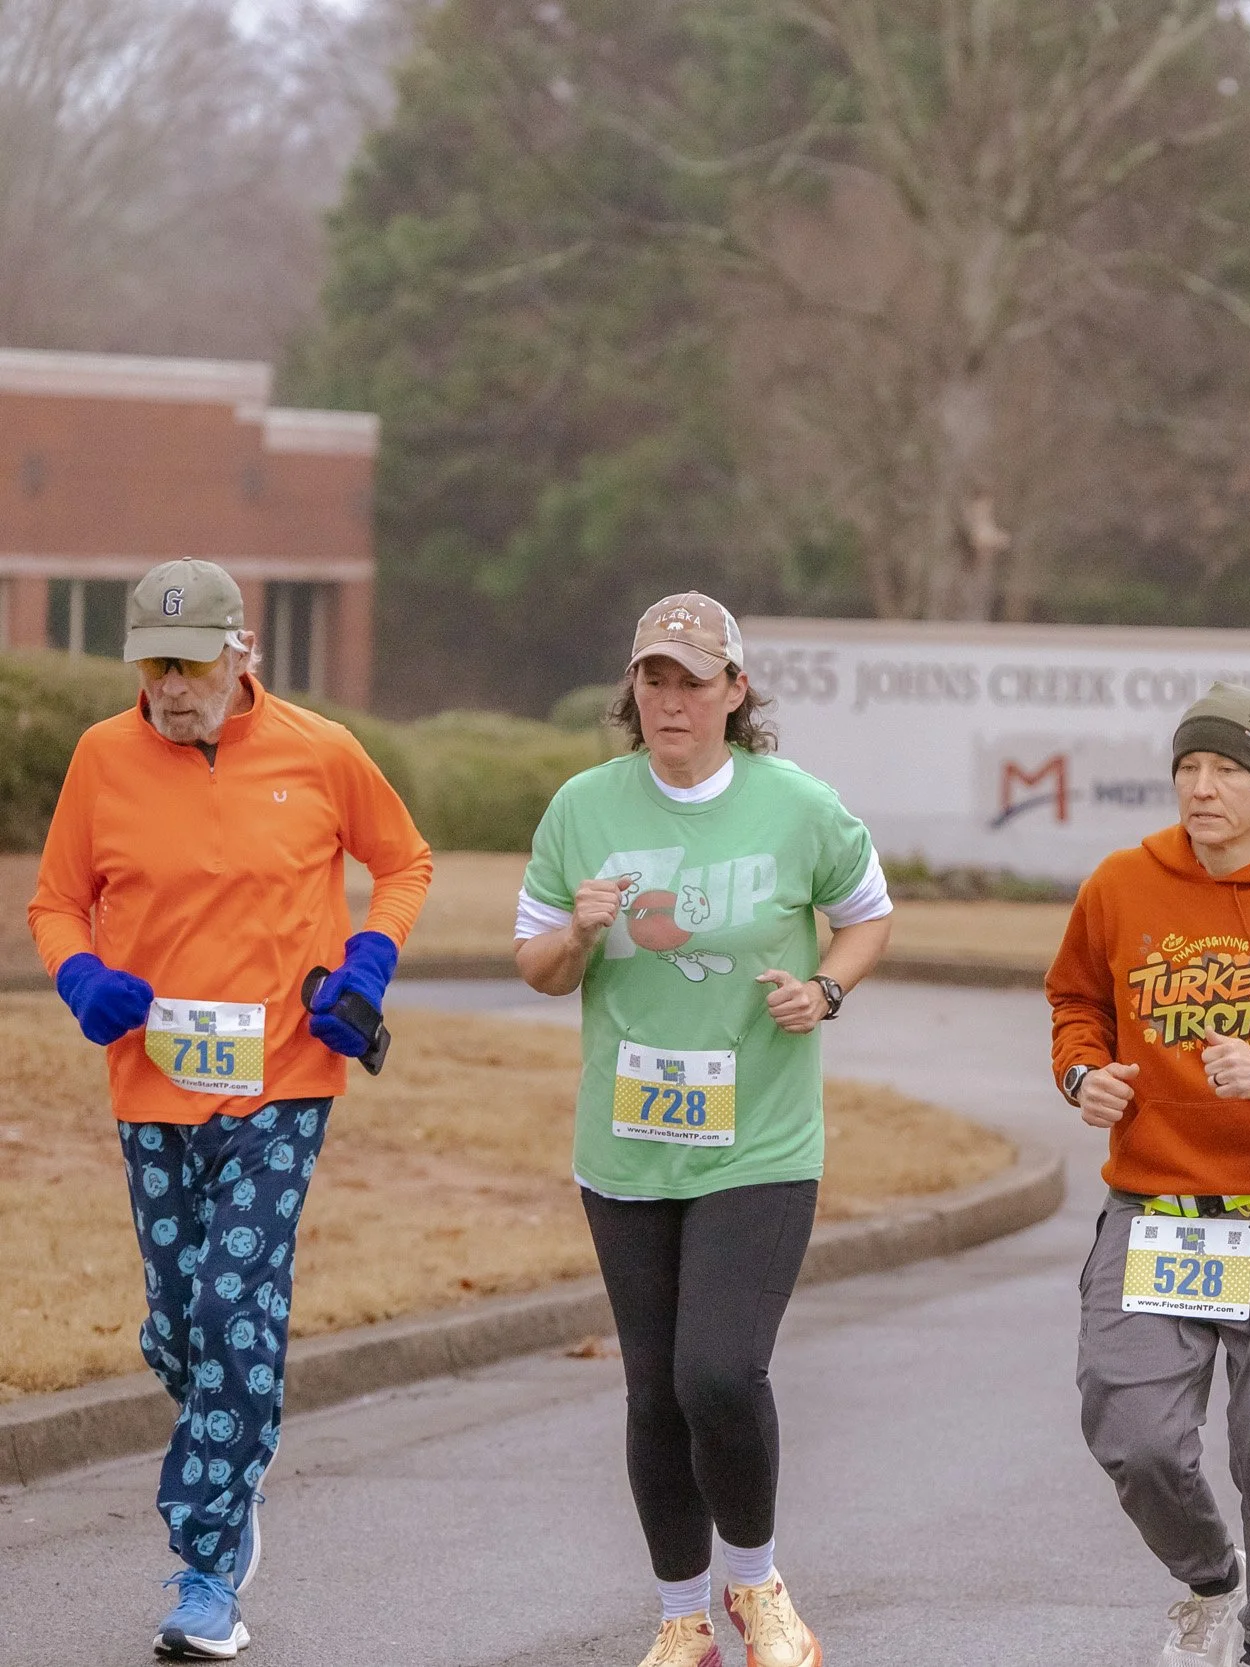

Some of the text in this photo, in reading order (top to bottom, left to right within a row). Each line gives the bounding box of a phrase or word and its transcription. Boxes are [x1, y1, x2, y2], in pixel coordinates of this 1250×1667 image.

[162, 586, 184, 617] G
[654, 612, 701, 629] ALASKA
[851, 660, 981, 714] JOHNS
[986, 663, 1118, 709] CREEK
[1172, 936, 1249, 963] THANKSGIVING
[174, 1038, 235, 1076] 715
[1181, 1041, 1196, 1052] 5K
[641, 1086, 706, 1126] 728
[627, 1126, 720, 1140] www.FiveStarNTP.com
[1154, 1256, 1224, 1297] 528
[1137, 1299, 1234, 1313] www.FiveStarNTP.com
